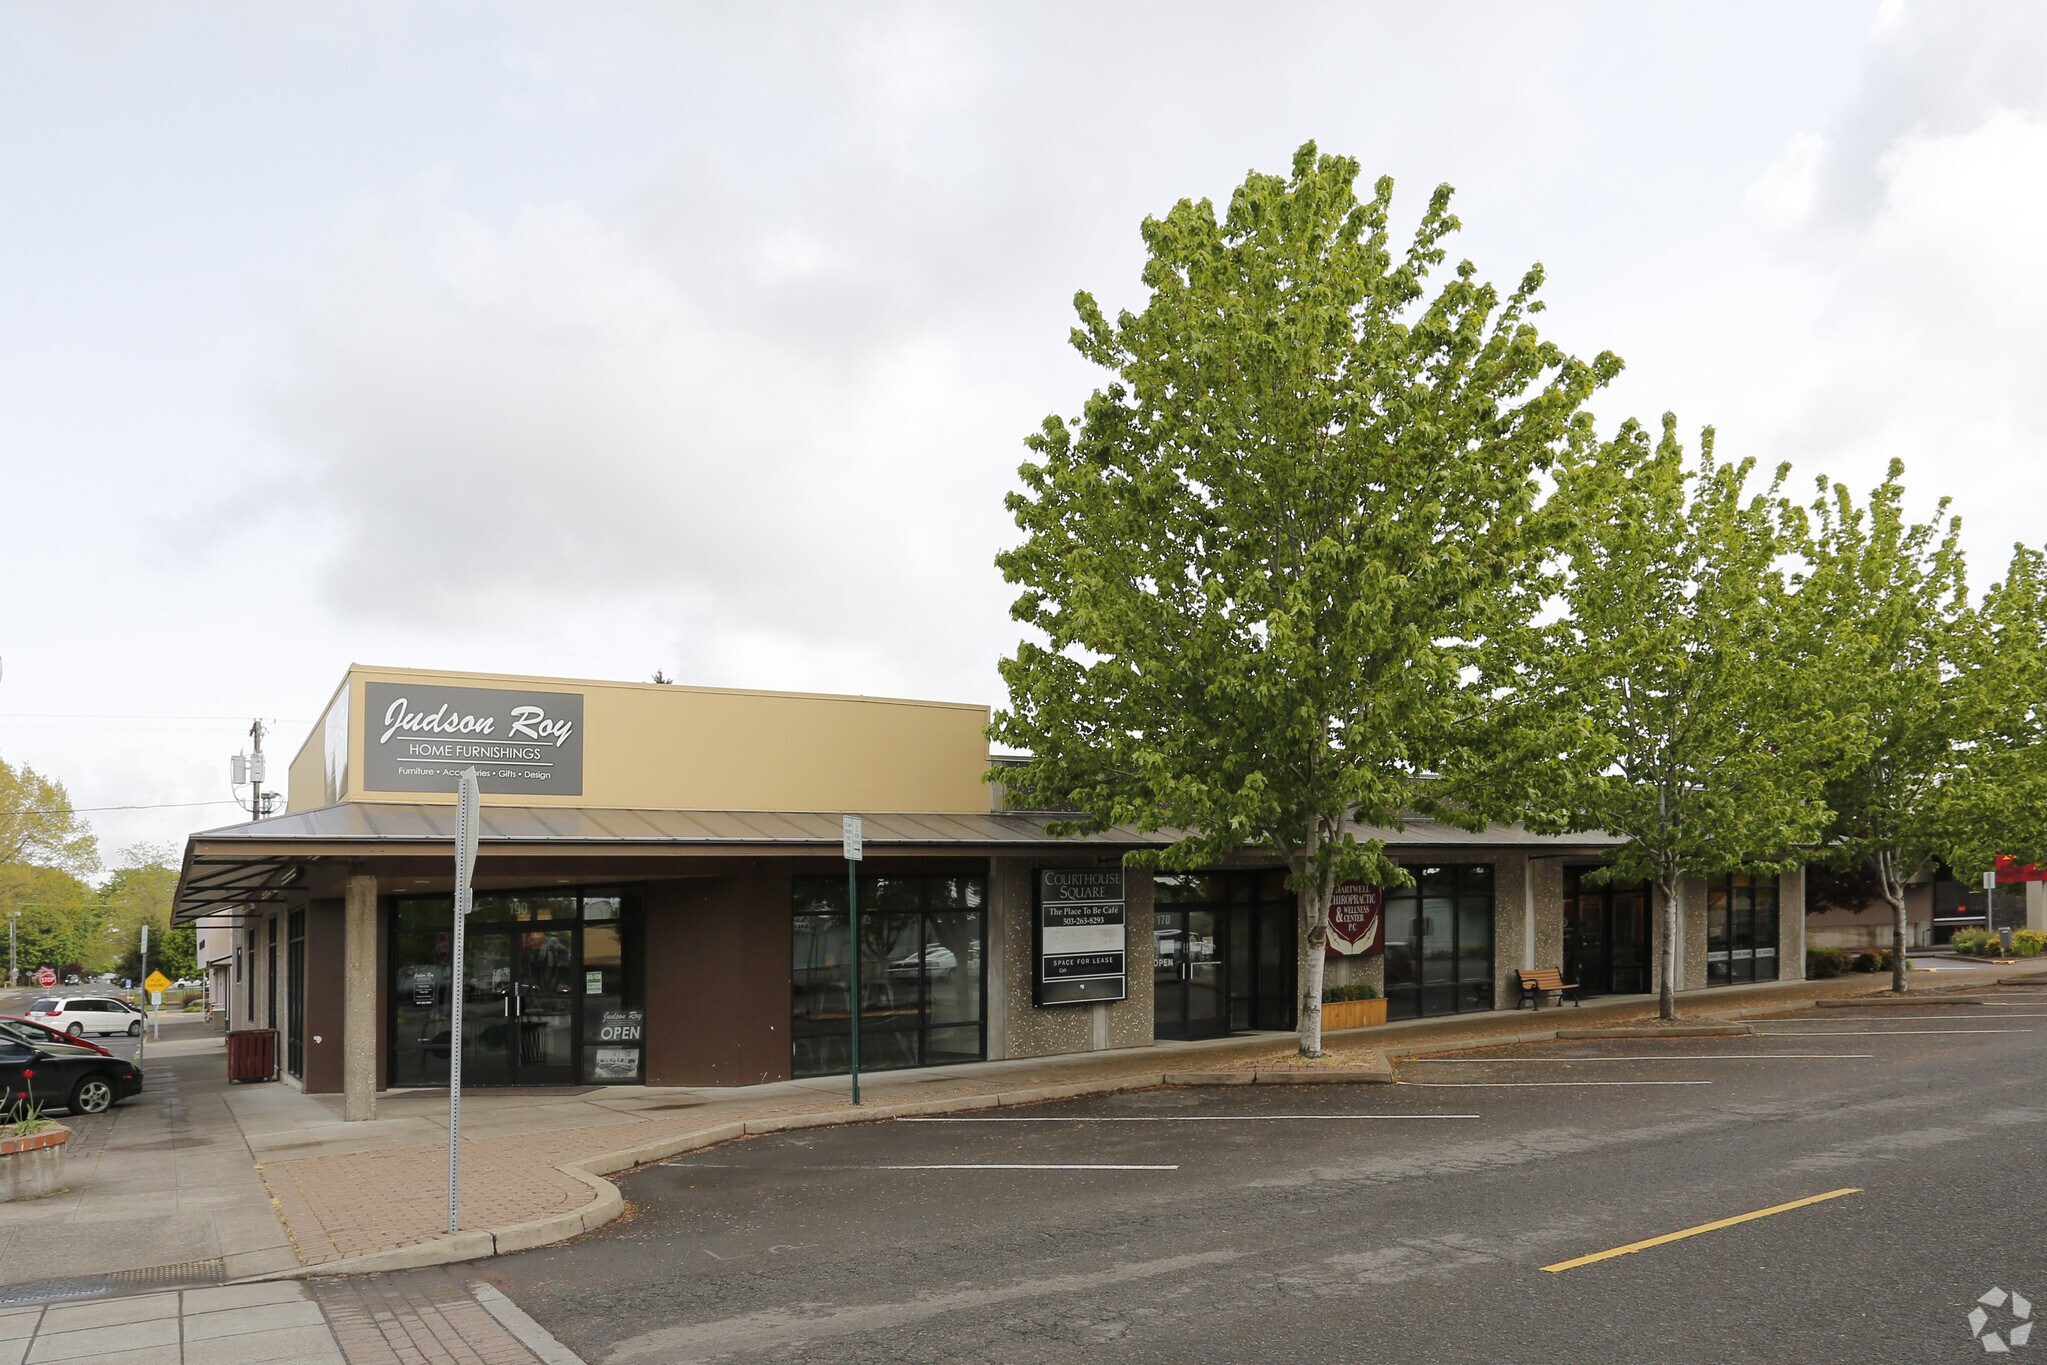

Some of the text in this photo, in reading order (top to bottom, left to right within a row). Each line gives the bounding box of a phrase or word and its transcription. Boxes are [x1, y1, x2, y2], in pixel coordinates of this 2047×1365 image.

[380, 697, 573, 748] Judson Roy
[409, 743, 541, 760] HOME FURNISHINGS
[398, 766, 551, 780] Furniture Acceries Gifts Design
[1045, 873, 1120, 885] COURTHOUSE
[1060, 886, 1105, 899] SQUARE
[1064, 907, 1081, 915] Place
[1083, 907, 1092, 915] To
[1092, 906, 1102, 914] Be
[1103, 906, 1118, 914] Café
[1336, 907, 1343, 922] &
[1153, 958, 1174, 967] OPEN
[600, 1026, 641, 1040] OPEN
